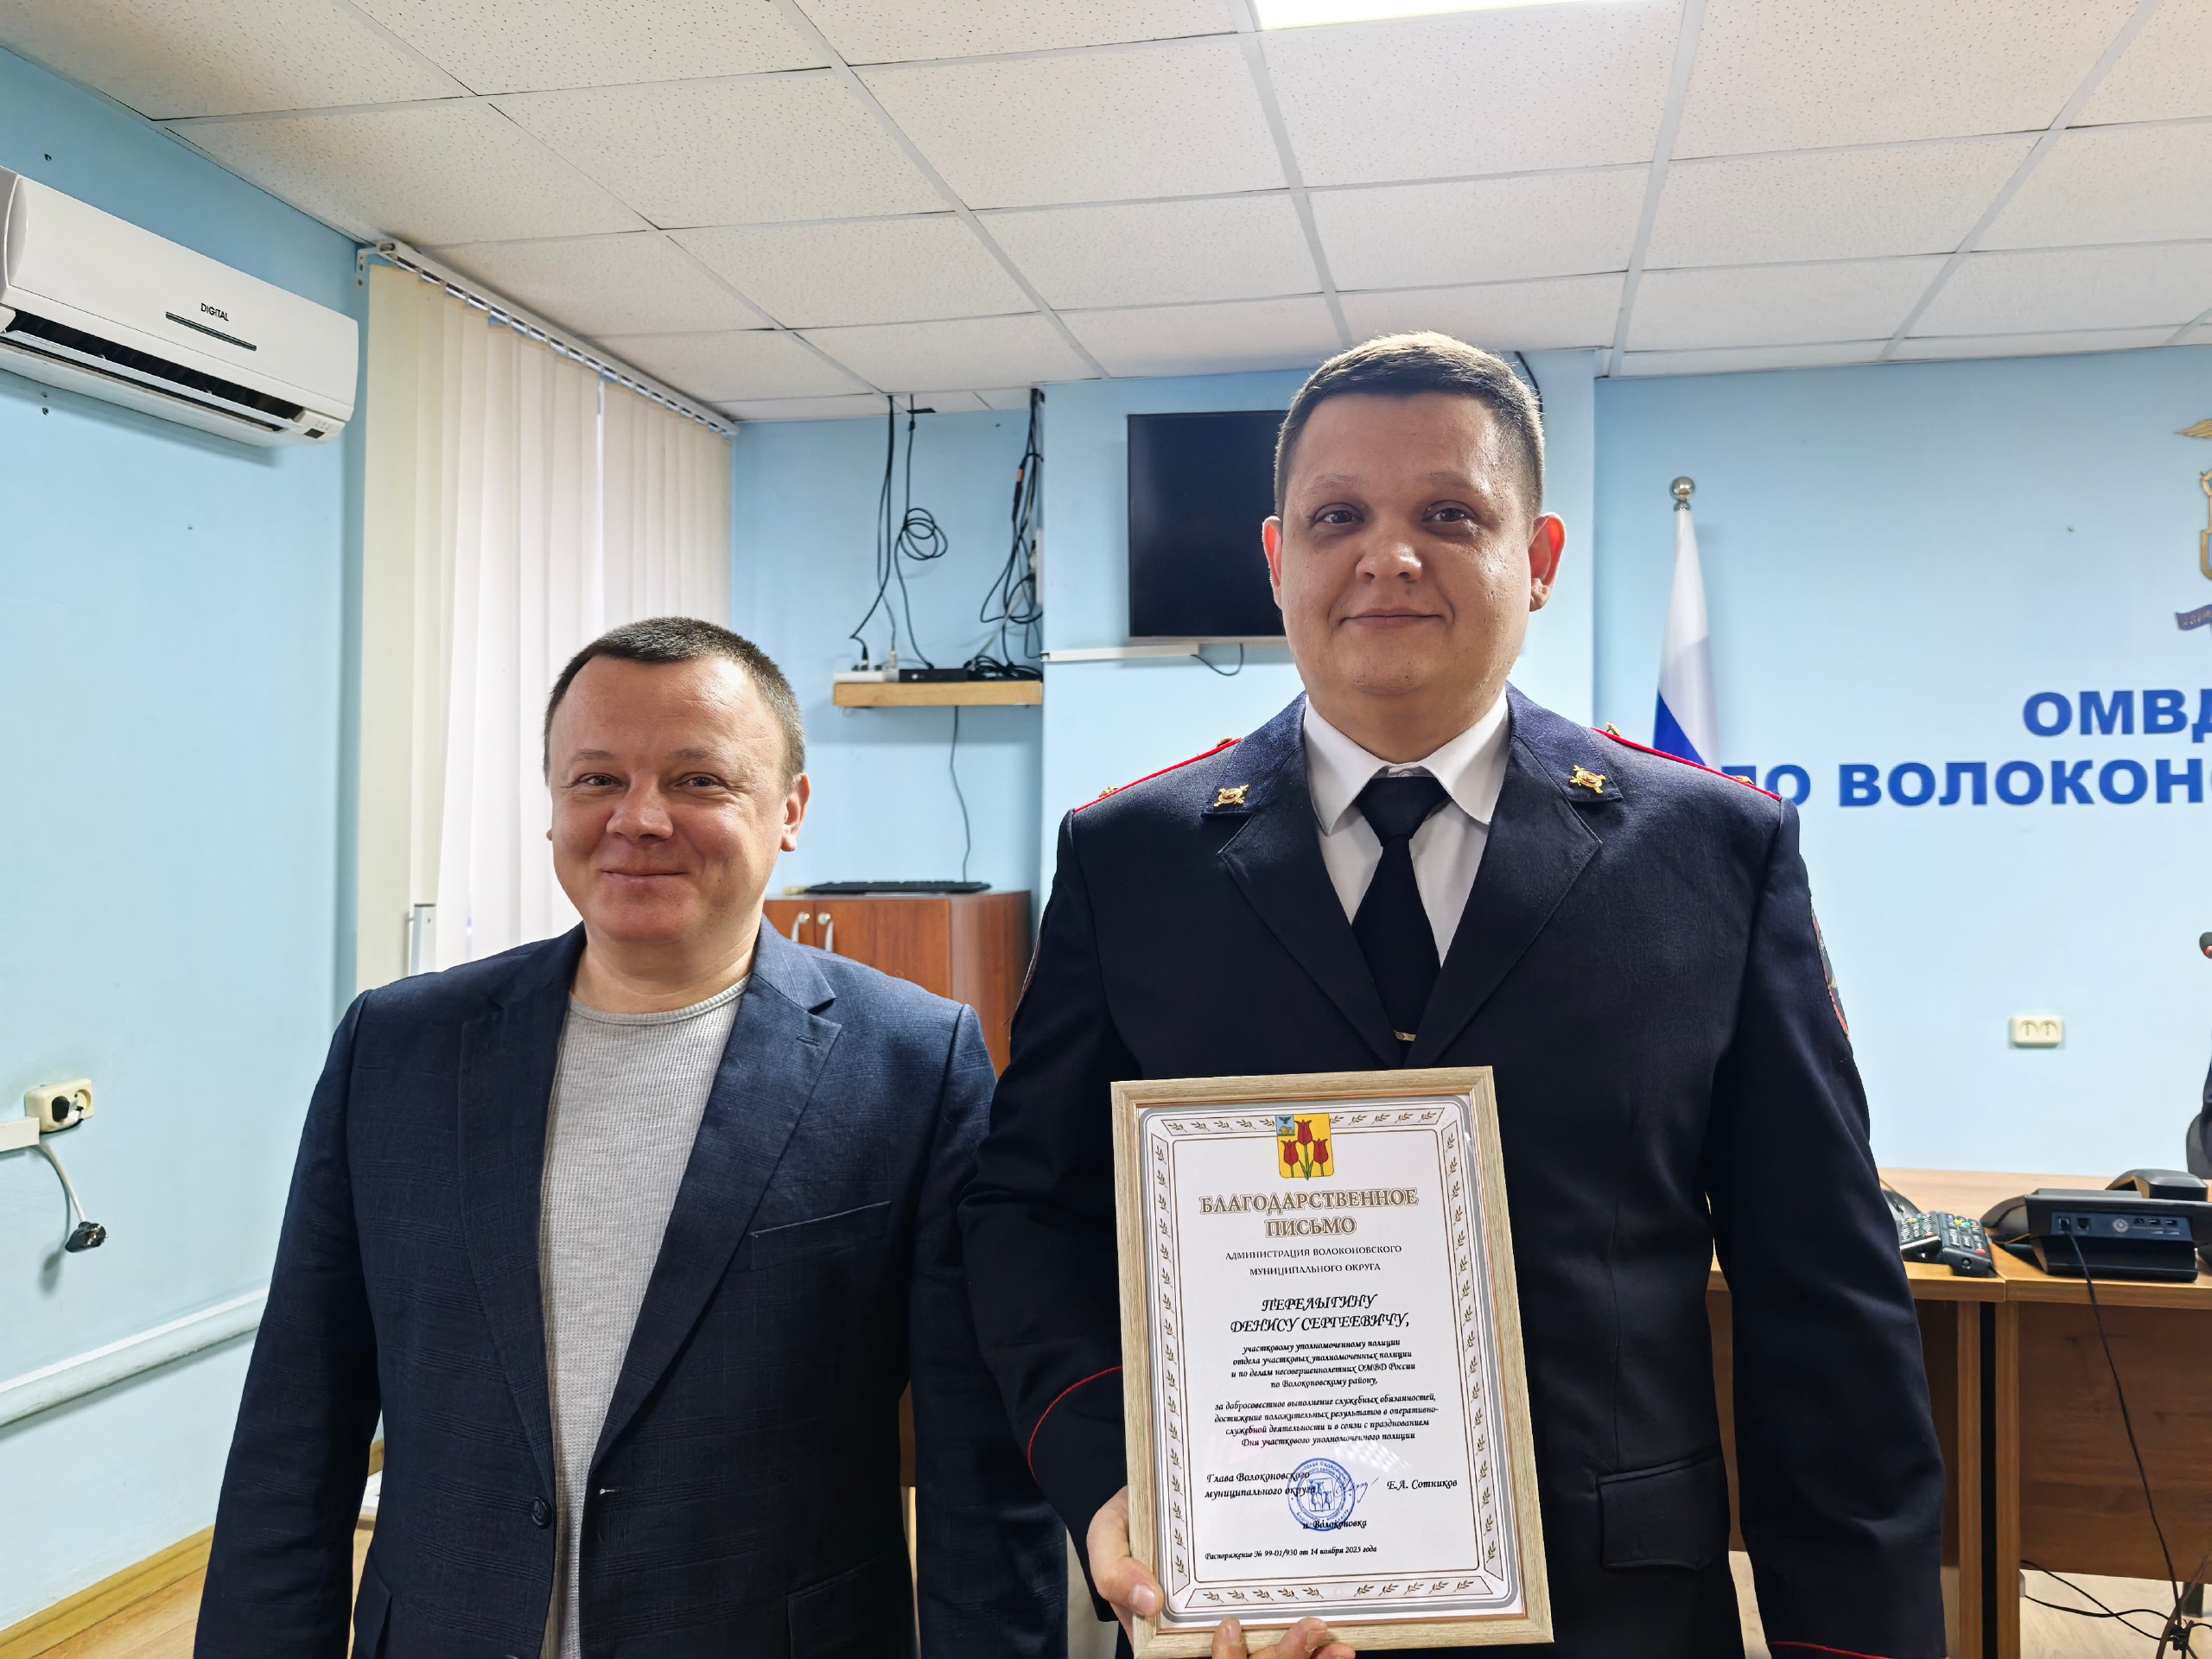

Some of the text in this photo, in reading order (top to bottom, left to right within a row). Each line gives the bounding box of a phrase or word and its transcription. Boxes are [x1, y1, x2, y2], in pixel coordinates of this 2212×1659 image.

[200, 302, 230, 321] DIGITAL
[1839, 758, 2212, 808] ВОЛОКОН
[1199, 1187, 1419, 1215] БЛАГОДАРСТВЕННОЕ
[1265, 1217, 1357, 1237] ПИСЬМО
[1225, 1244, 1402, 1261] АДМИНИСТРАЦИЯ ВОЛОКОНОВСКОГО
[1249, 1262, 1381, 1276] МУНИЦИПАЛЬНОГО ОКРУГА
[1262, 1294, 1378, 1312] ПЕРЕЛЫГИНУ
[1230, 1313, 1409, 1332] ДЕНИСУ СЕРГЕЕВИЧУ,
[1242, 1344, 1294, 1355] участковому
[1295, 1341, 1365, 1352] уполномоченному
[1233, 1357, 1260, 1365] отдела
[1262, 1356, 1312, 1366] участковых
[1309, 1353, 1378, 1363] уполномоченных
[1249, 1368, 1272, 1376] делам
[1275, 1366, 1357, 1376] несовершеннолетних
[1358, 1363, 1387, 1371] ОМВД
[1282, 1379, 1346, 1388] Волоконовскому
[1348, 1376, 1377, 1387] району,
[1226, 1401, 1285, 1412] добросовестное
[1335, 1395, 1380, 1407] служебных
[1380, 1393, 1436, 1403] обязанностей,
[1215, 1414, 1262, 1423] достижение
[1264, 1412, 1330, 1421] положительных
[1330, 1409, 1382, 1420] результатов
[1389, 1407, 1439, 1416] оперативно-
[1225, 1425, 1267, 1437] служебной
[1269, 1424, 1325, 1433] деятельности
[1370, 1419, 1429, 1430] празднованием
[1261, 1438, 1310, 1448] участкового
[1311, 1433, 1380, 1446] уполномоченного
[1382, 1433, 1415, 1441] полиции
[1206, 1471, 1310, 1483] Глава Волоконовского
[1387, 1479, 1458, 1490] Е.А. Сотников
[1205, 1486, 1316, 1500] муниципального округа
[1205, 1552, 1253, 1560] Распоряжение
[1264, 1548, 1298, 1558] 99-01/930
[1320, 1546, 1344, 1555] ноября
